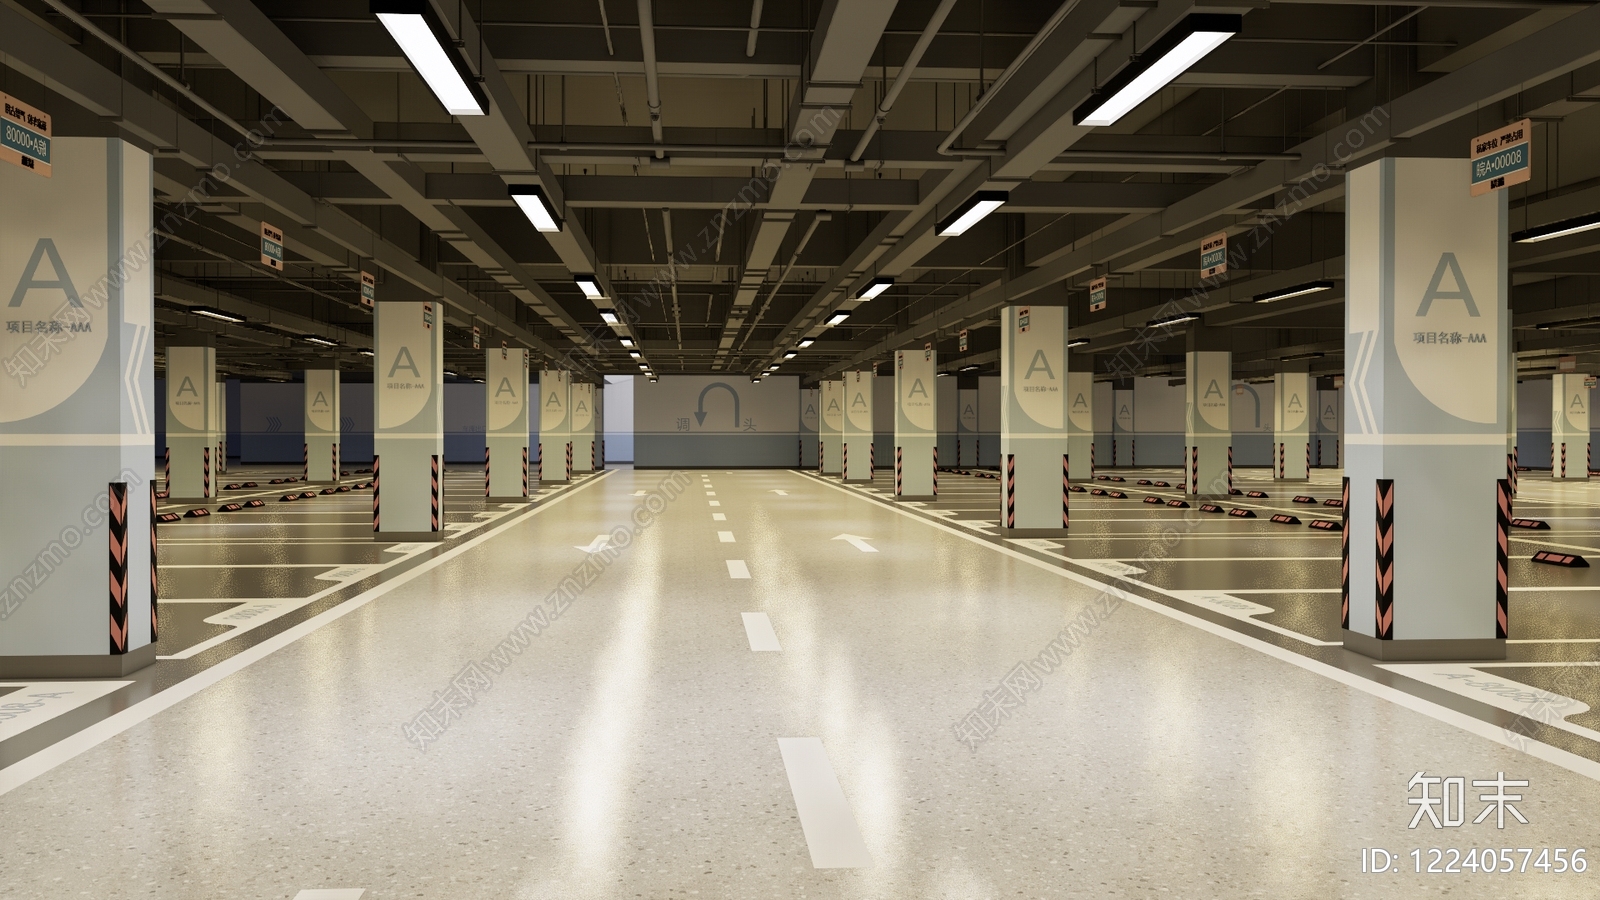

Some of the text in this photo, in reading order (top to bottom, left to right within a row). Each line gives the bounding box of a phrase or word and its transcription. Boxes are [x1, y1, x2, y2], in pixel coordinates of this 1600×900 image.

[8, 238, 84, 307] A
[1415, 252, 1481, 317] A
[1413, 331, 1487, 344] 项目名称-AAA
[387, 346, 421, 378] A
[1024, 349, 1055, 380] A
[176, 376, 198, 397] A
[495, 377, 516, 397] A
[908, 378, 928, 398] A
[1204, 379, 1224, 399] A
[312, 391, 328, 406] A
[545, 391, 561, 407] A
[575, 400, 588, 412] A
[827, 398, 840, 411] A
[852, 392, 867, 407] A
[1073, 393, 1088, 408] A
[1288, 393, 1302, 408] A
[1570, 394, 1584, 408] A
[805, 404, 816, 415] A
[964, 404, 974, 415] A
[1119, 404, 1130, 415] A
[1324, 405, 1335, 415] A
[677, 418, 757, 431] 调 头
